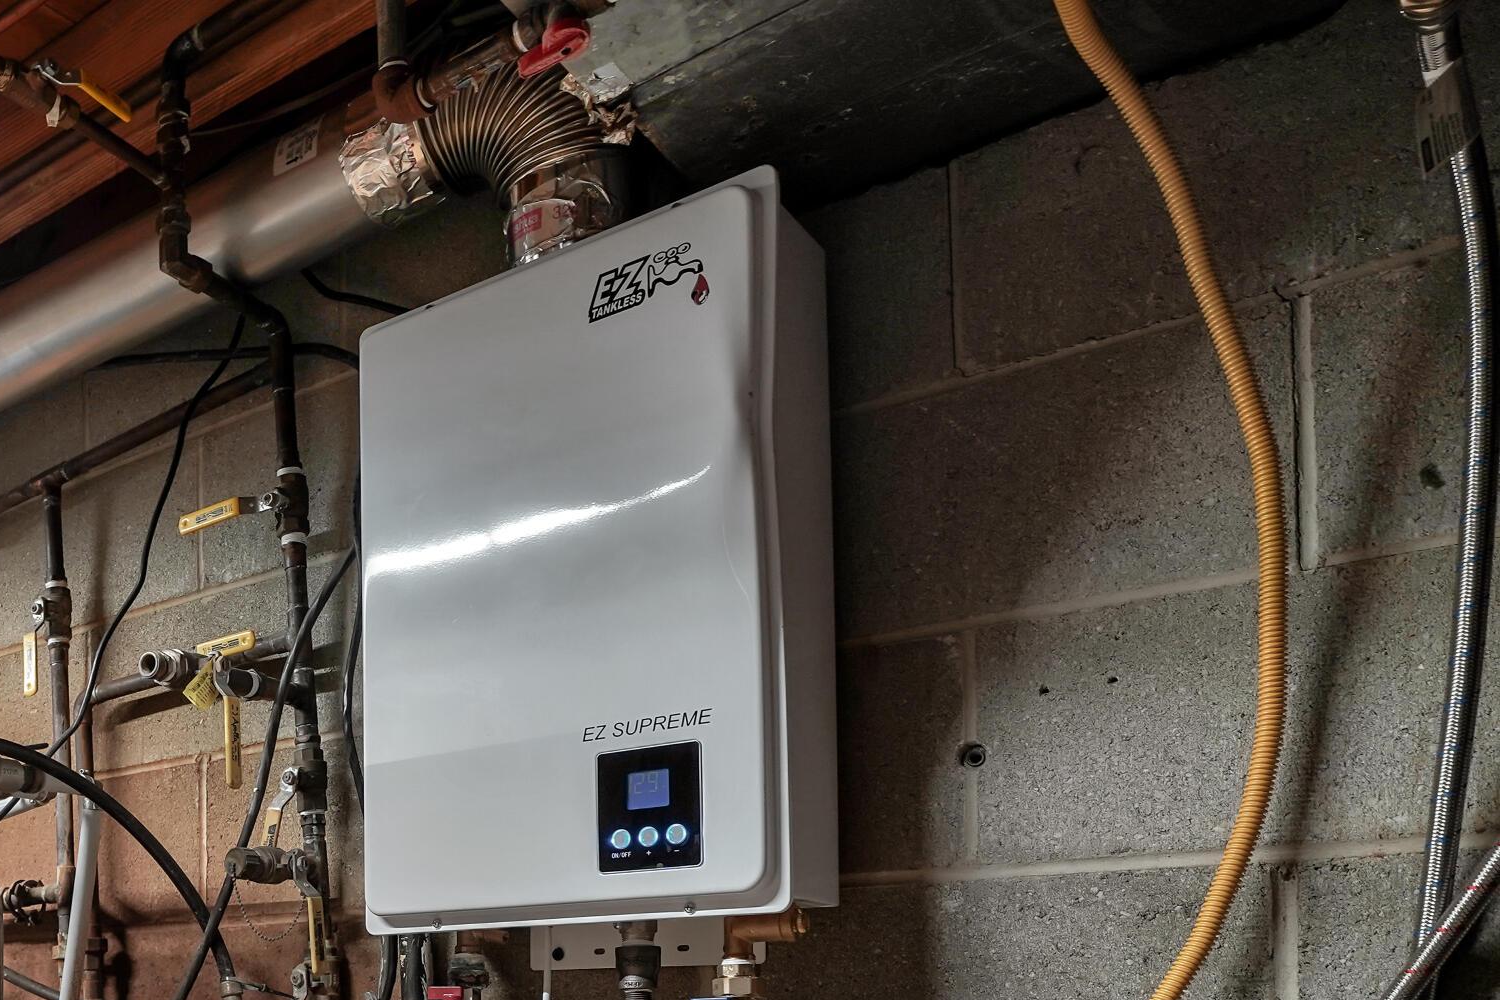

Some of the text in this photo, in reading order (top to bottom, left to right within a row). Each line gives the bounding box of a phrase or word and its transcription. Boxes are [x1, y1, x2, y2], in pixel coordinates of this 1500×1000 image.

[592, 292, 643, 319] TANKLESS
[582, 708, 713, 742] EZ SUPREME
[611, 851, 632, 859] ON/OFF
